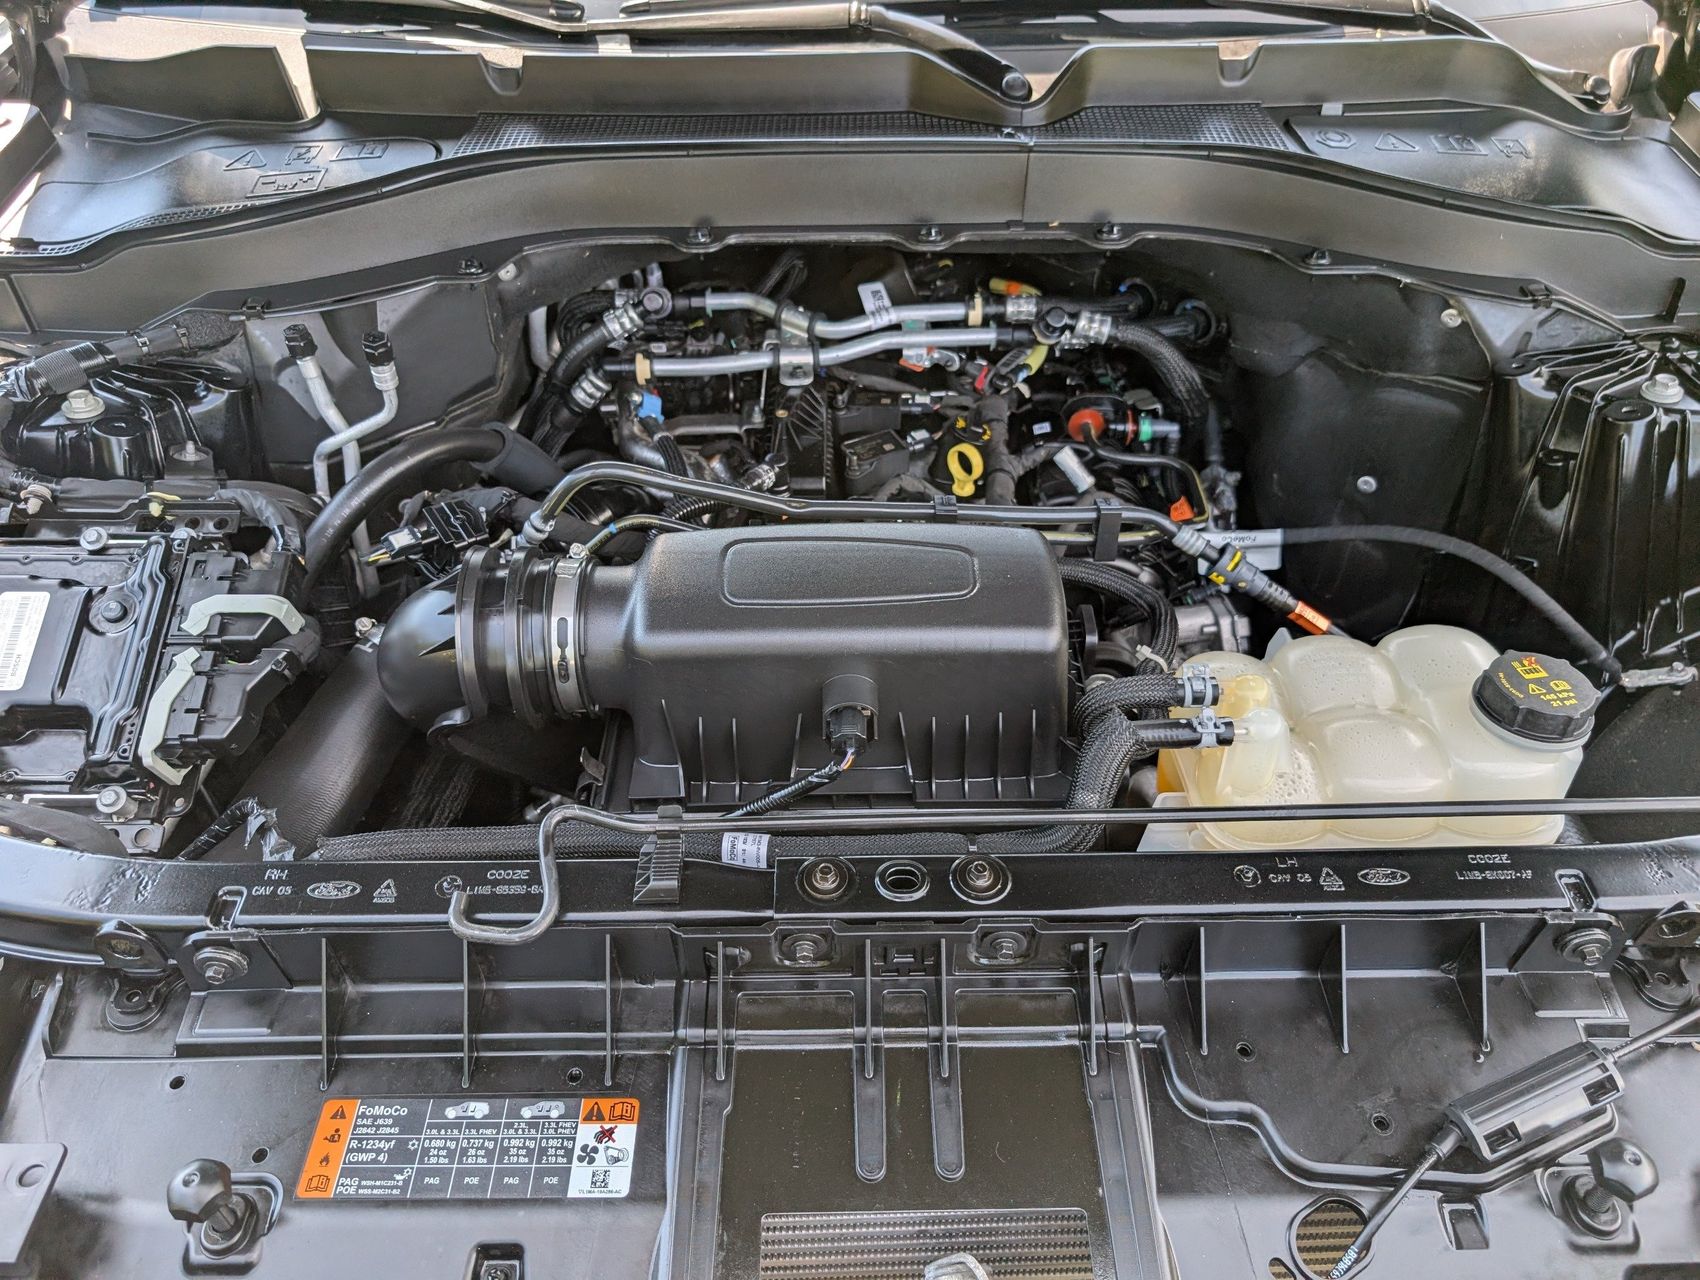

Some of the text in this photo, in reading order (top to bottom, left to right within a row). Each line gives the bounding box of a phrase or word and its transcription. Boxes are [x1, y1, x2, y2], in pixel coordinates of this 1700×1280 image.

[729, 836, 738, 862] FoMoCo
[358, 1105, 408, 1116] FoMoCo
[353, 1126, 400, 1134] J2842 J2845
[349, 1139, 396, 1151] R-1234yf
[424, 1139, 456, 1150] 0.680 kg
[462, 1139, 495, 1150] 0.737 kg
[503, 1138, 536, 1149] 0.992 kg
[542, 1138, 574, 1149] 0.992 kg
[429, 1148, 438, 1156] 24
[467, 1148, 476, 1156] 26
[345, 1152, 388, 1164] (GWP 4)
[424, 1156, 449, 1164] 1.50 lbs
[462, 1156, 488, 1164] 1.63 lbs
[338, 1178, 360, 1186] PAG
[336, 1186, 357, 1194] POE
